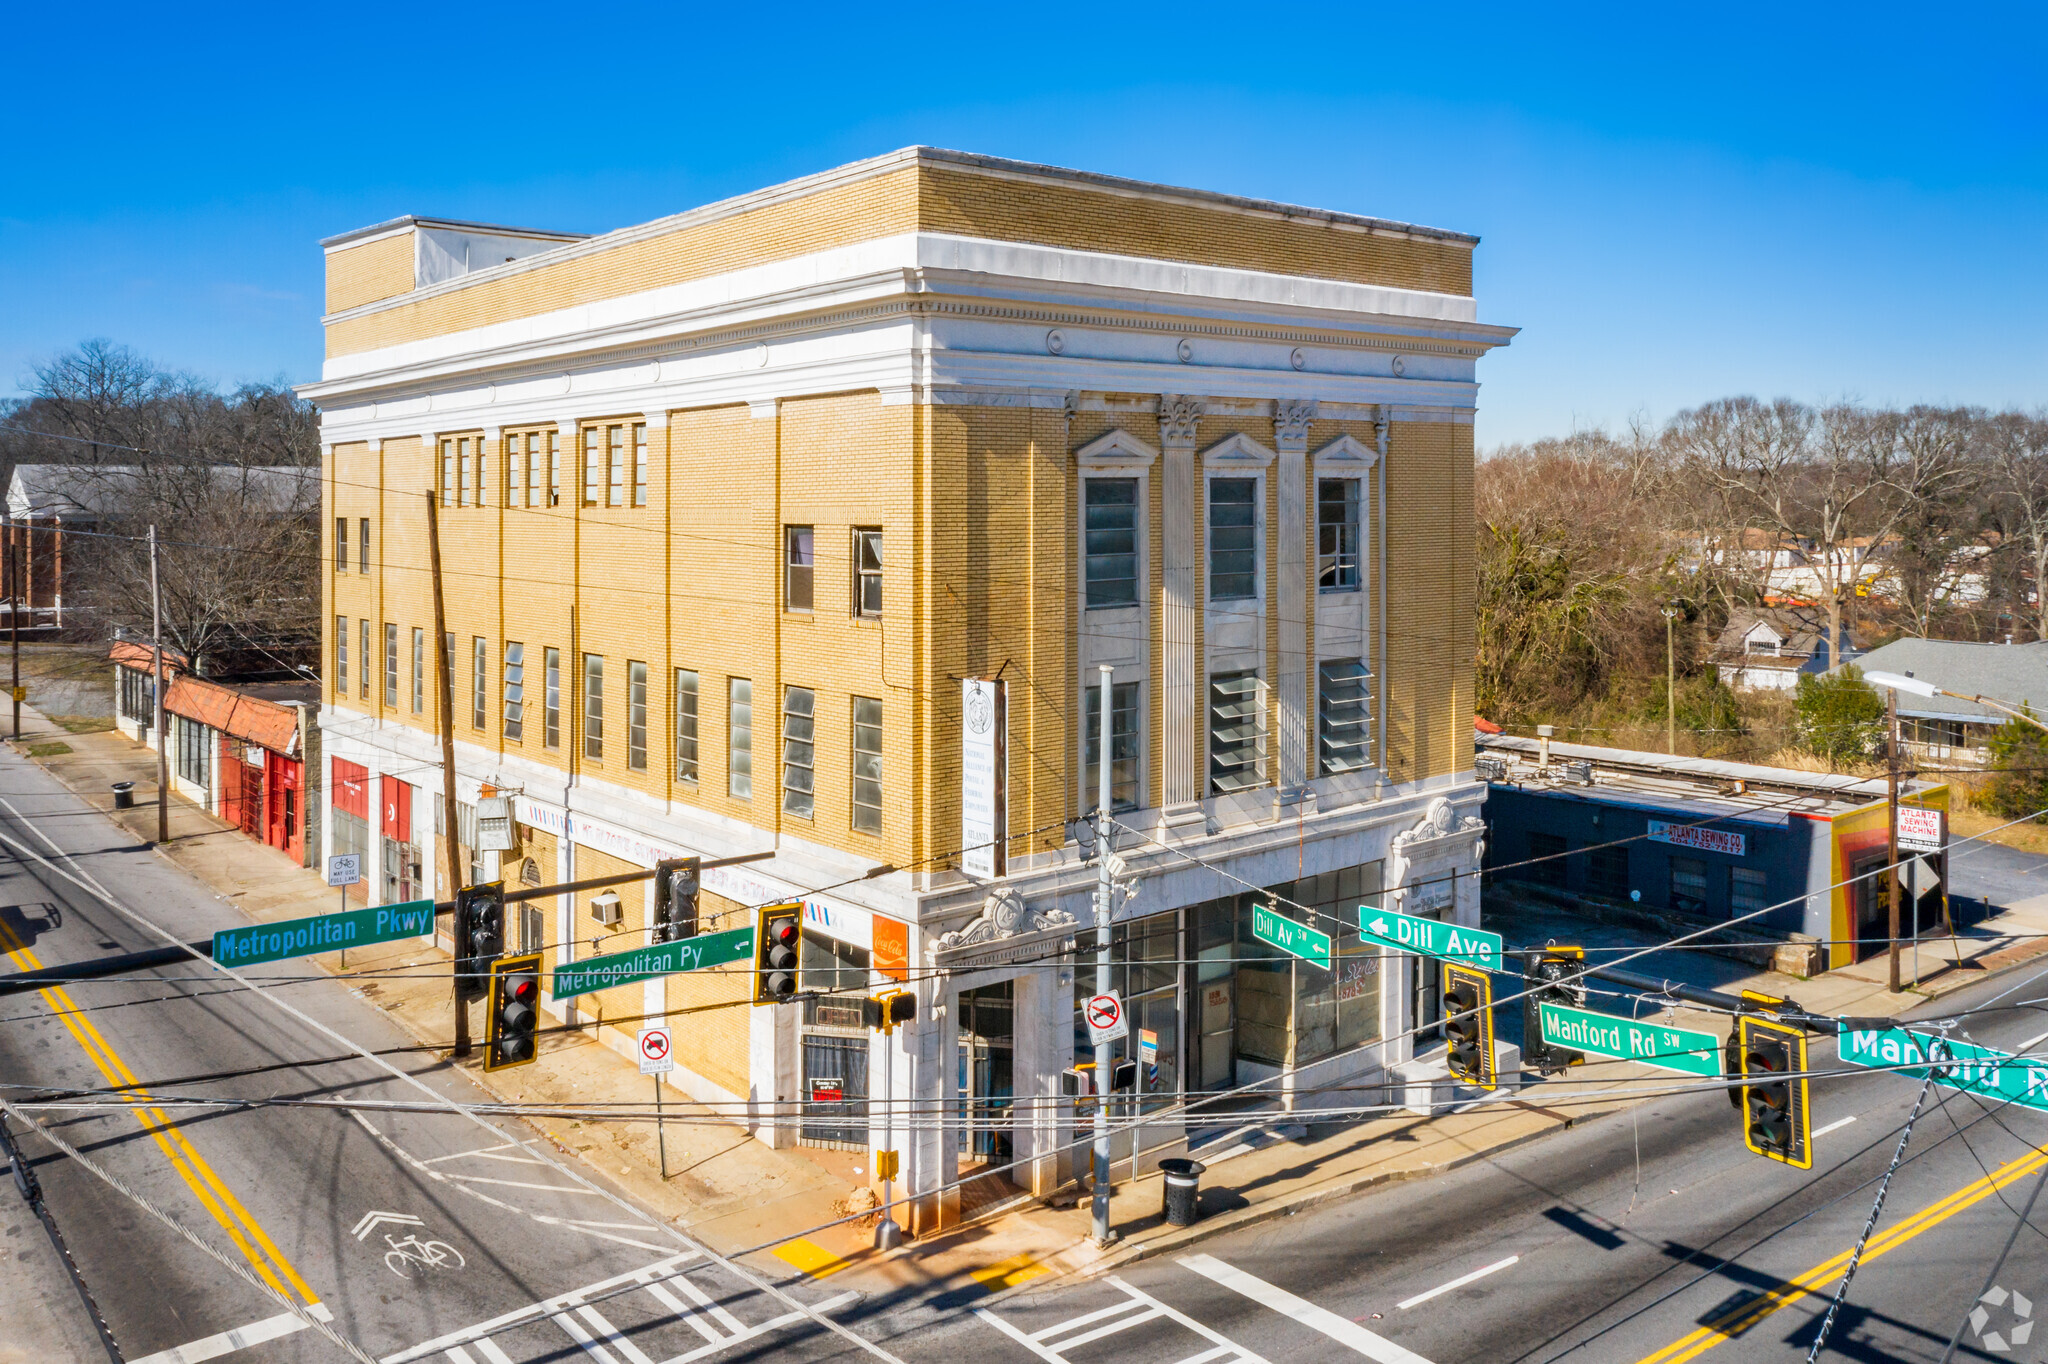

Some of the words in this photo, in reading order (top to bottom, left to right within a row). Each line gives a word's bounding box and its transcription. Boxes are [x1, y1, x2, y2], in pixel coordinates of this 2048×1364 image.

[1900, 809, 1937, 819] ATLANTA
[1904, 817, 1934, 828] SEWING
[1669, 824, 1699, 840] ATLANTA
[1701, 829, 1728, 846] SEWING
[1900, 825, 1938, 836] MACHINE
[219, 918, 356, 961] Metropolitan
[376, 908, 429, 936] Pkwy
[1257, 912, 1273, 937] Dill
[1278, 922, 1293, 946] Av
[1297, 928, 1307, 942] SW
[1397, 917, 1432, 949] Dill
[1446, 929, 1493, 962] Ave
[558, 952, 672, 994] Metropolitan
[680, 945, 703, 970] Py
[818, 1008, 860, 1027] OPEN
[1546, 1011, 1621, 1051] Manford
[1629, 1027, 1656, 1057] Rd
[1663, 1032, 1680, 1048] SW
